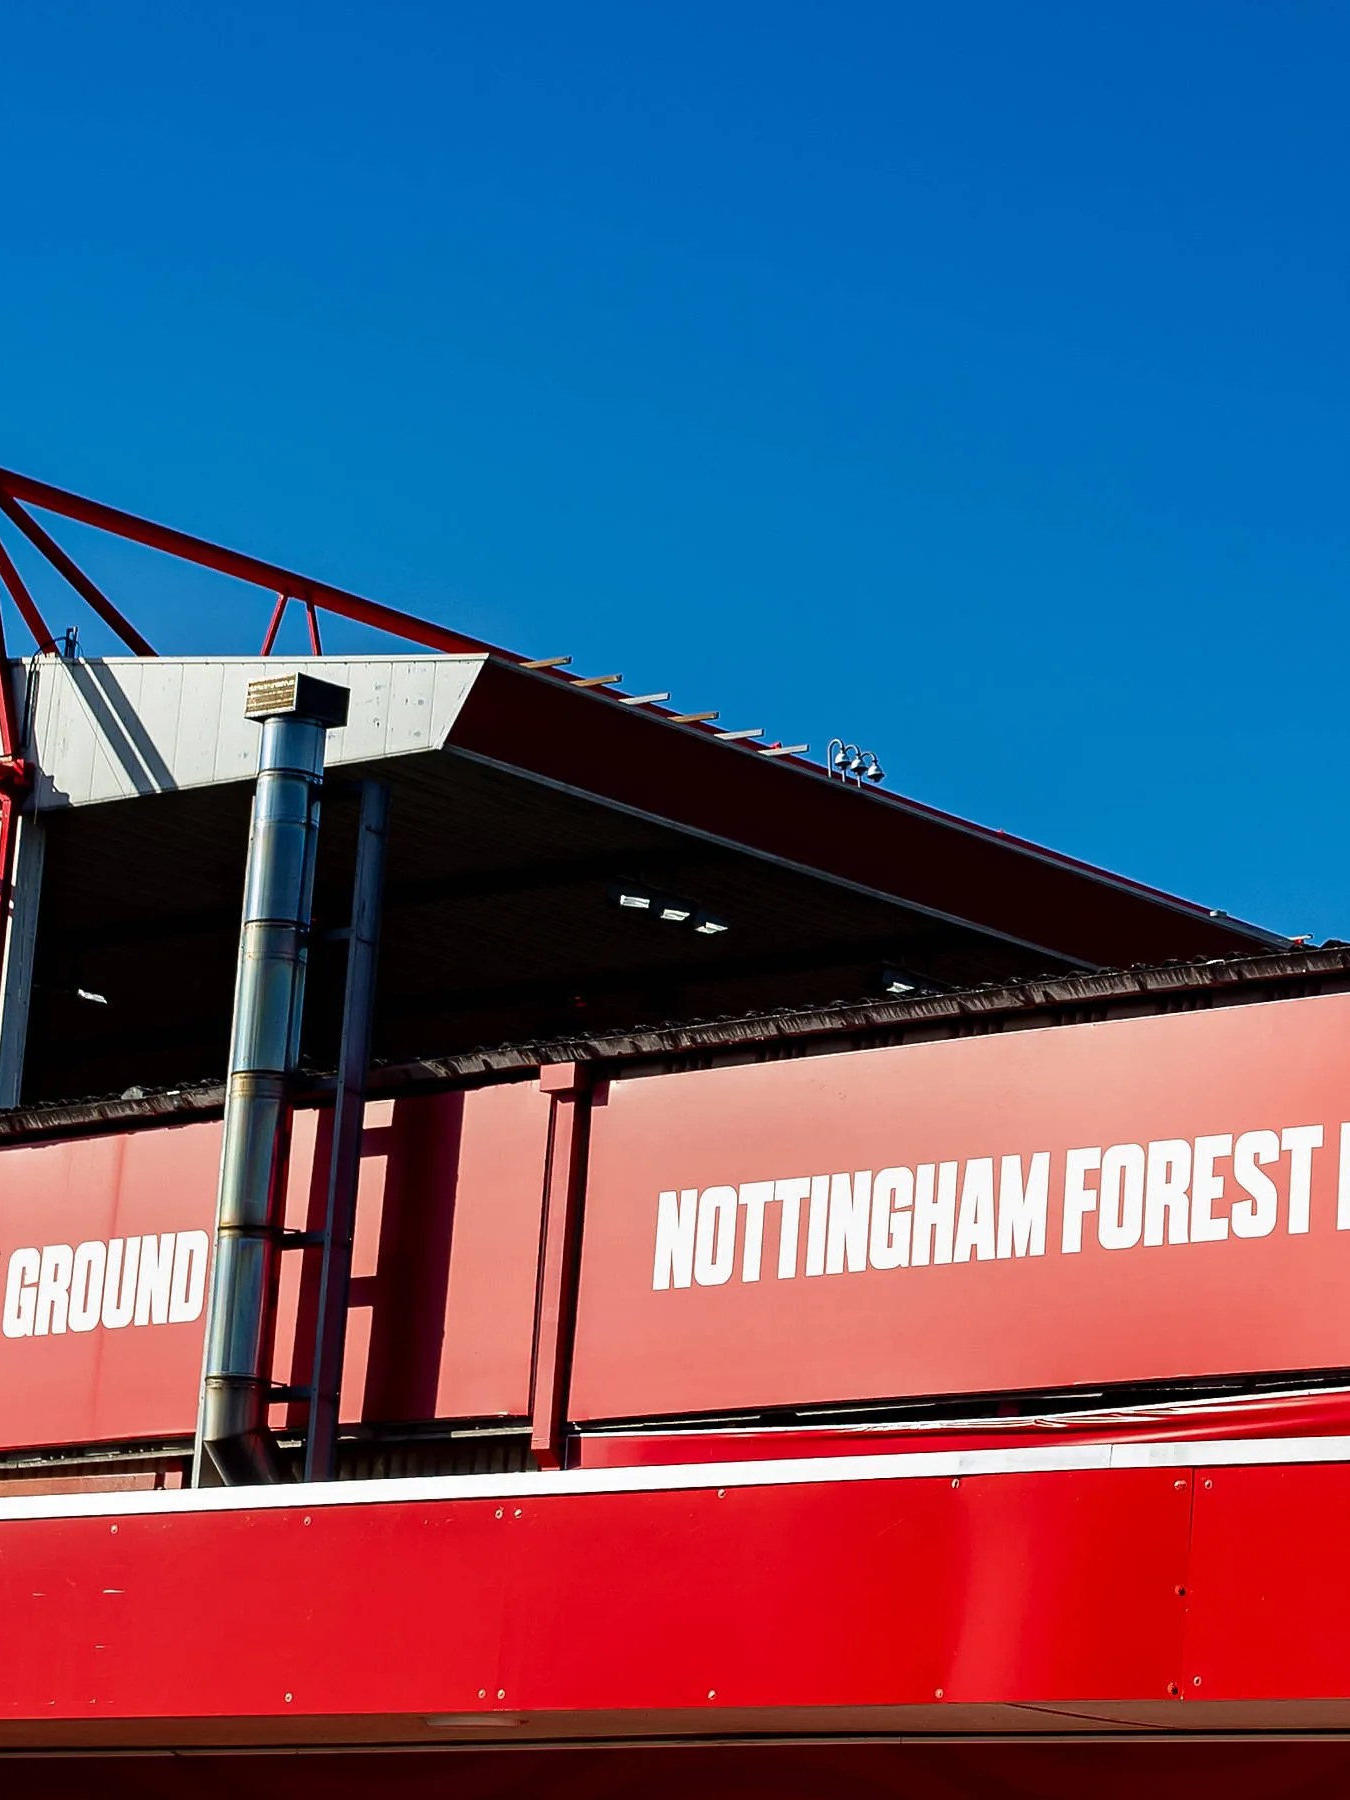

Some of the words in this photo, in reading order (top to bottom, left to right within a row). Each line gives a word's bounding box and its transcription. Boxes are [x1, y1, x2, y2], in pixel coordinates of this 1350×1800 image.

[652, 1151, 1051, 1291] NOTTINGHAM
[1061, 1124, 1324, 1254] FOREST
[2, 1230, 209, 1338] GROUND
